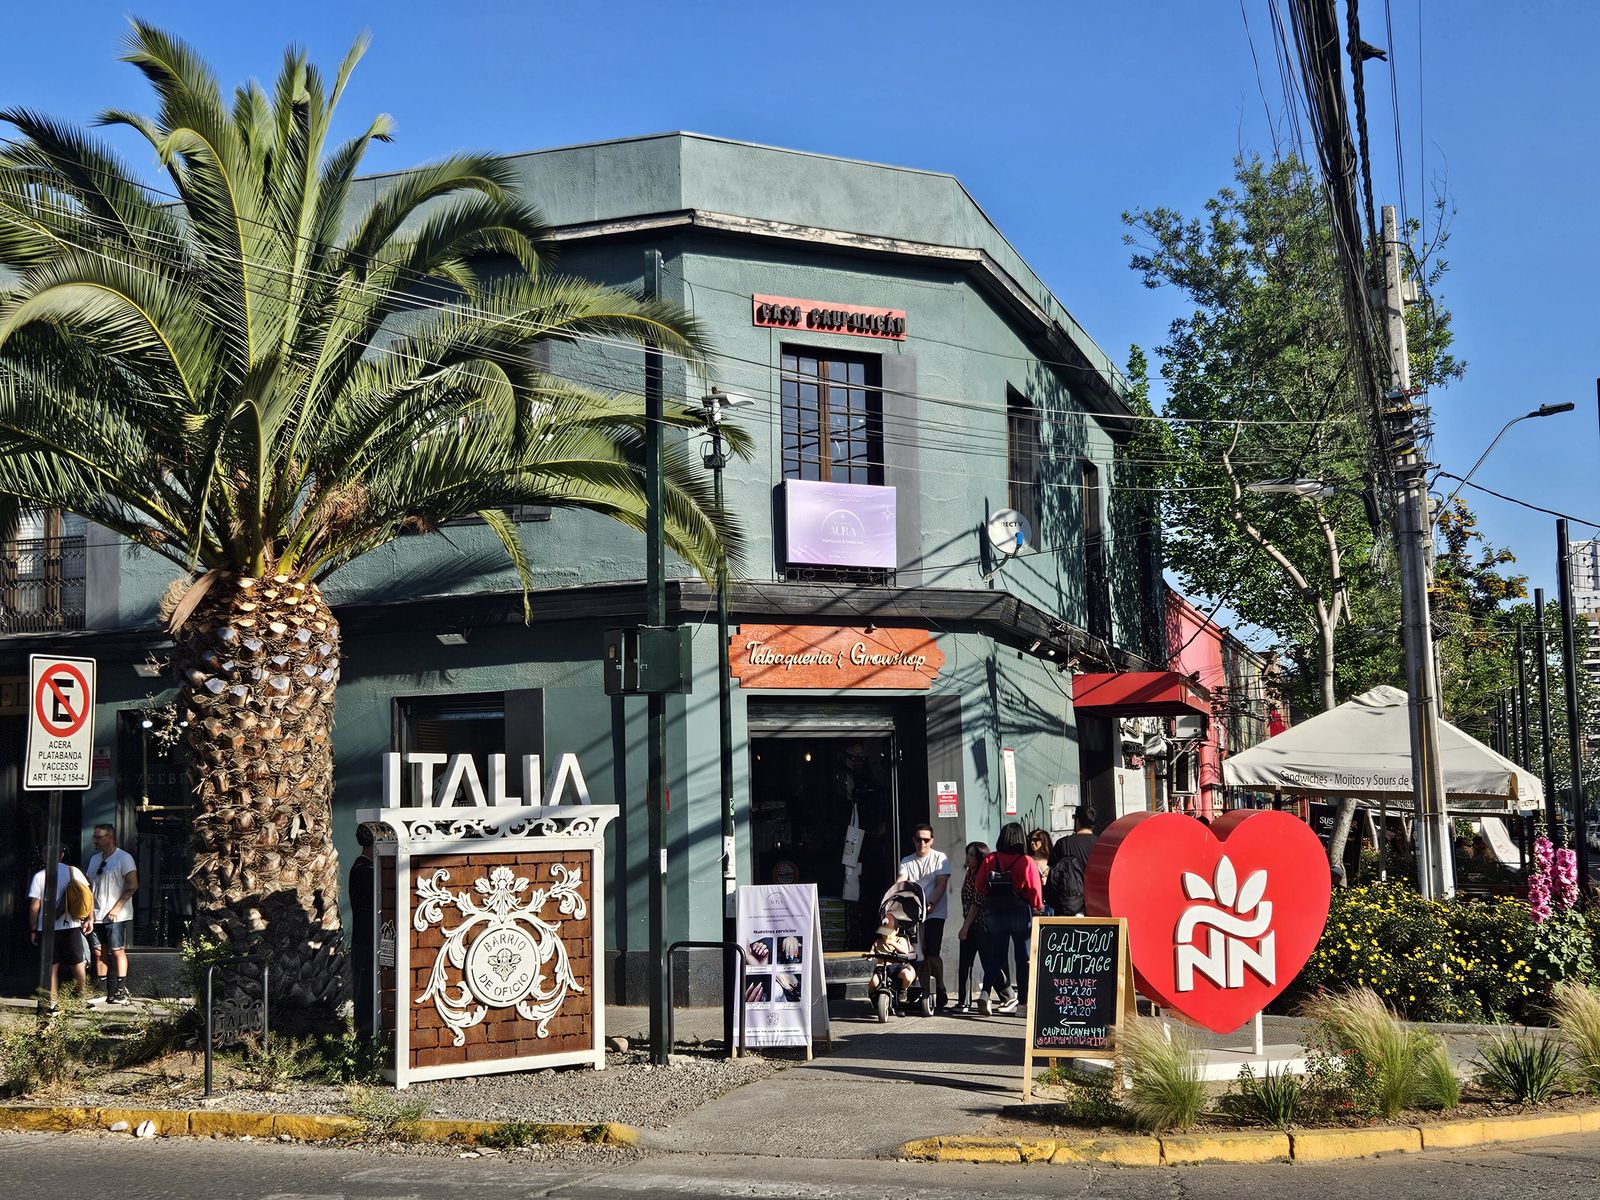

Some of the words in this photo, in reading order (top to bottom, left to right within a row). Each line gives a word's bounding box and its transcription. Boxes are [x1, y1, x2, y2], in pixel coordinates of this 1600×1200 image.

[761, 304, 803, 324] CASA
[810, 309, 906, 333] CAUPOLICÁN
[850, 641, 926, 670] Growshop
[48, 741, 72, 749] ACERA
[38, 751, 82, 760] PLATABANDA
[47, 762, 79, 771] ACCESOS
[32, 773, 48, 782] ART.
[50, 773, 66, 783] 154-2
[68, 773, 84, 782] 154-4
[383, 752, 592, 809] ITALIA
[1280, 770, 1327, 784] Sandwiches
[1334, 773, 1364, 787] Mojitos
[1366, 776, 1372, 788] y
[1373, 774, 1396, 786] Sours
[1398, 774, 1409, 786] de
[776, 928, 797, 936] servicios
[483, 936, 528, 953] BARRIO
[477, 972, 493, 992] DE
[493, 972, 531, 999] OFICIO
